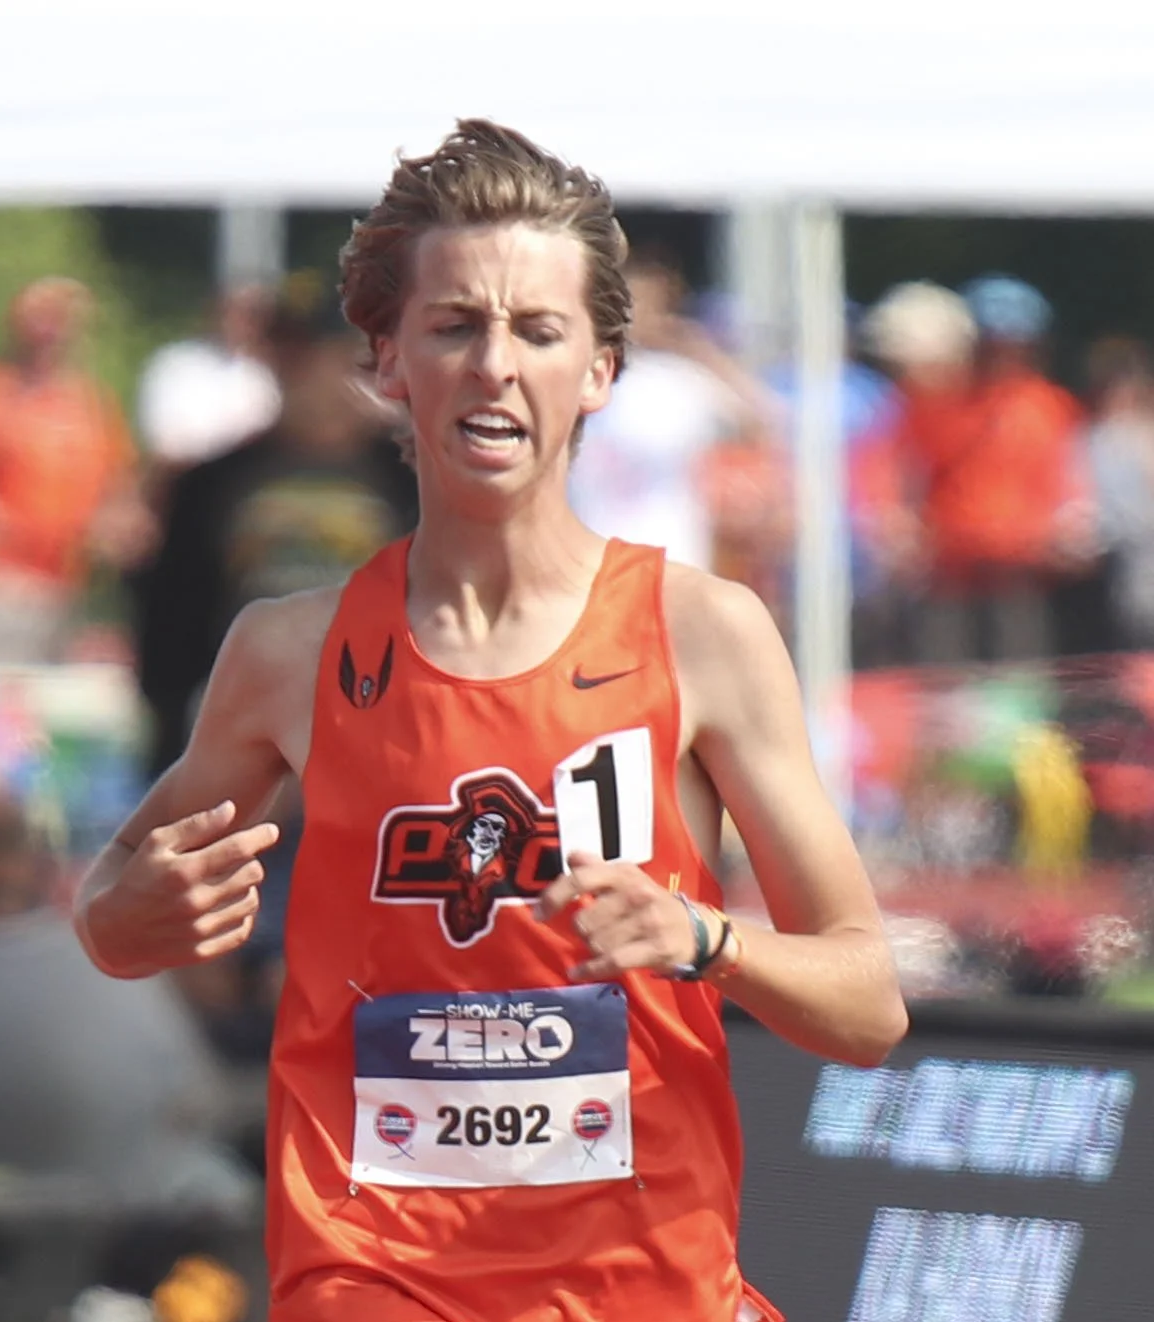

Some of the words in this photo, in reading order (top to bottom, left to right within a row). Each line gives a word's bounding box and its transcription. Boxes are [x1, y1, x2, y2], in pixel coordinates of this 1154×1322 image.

[571, 743, 622, 862] 1
[445, 1002, 535, 1020] SHOW-ME
[409, 1013, 574, 1062] ZERO
[436, 1103, 552, 1147] 2692
